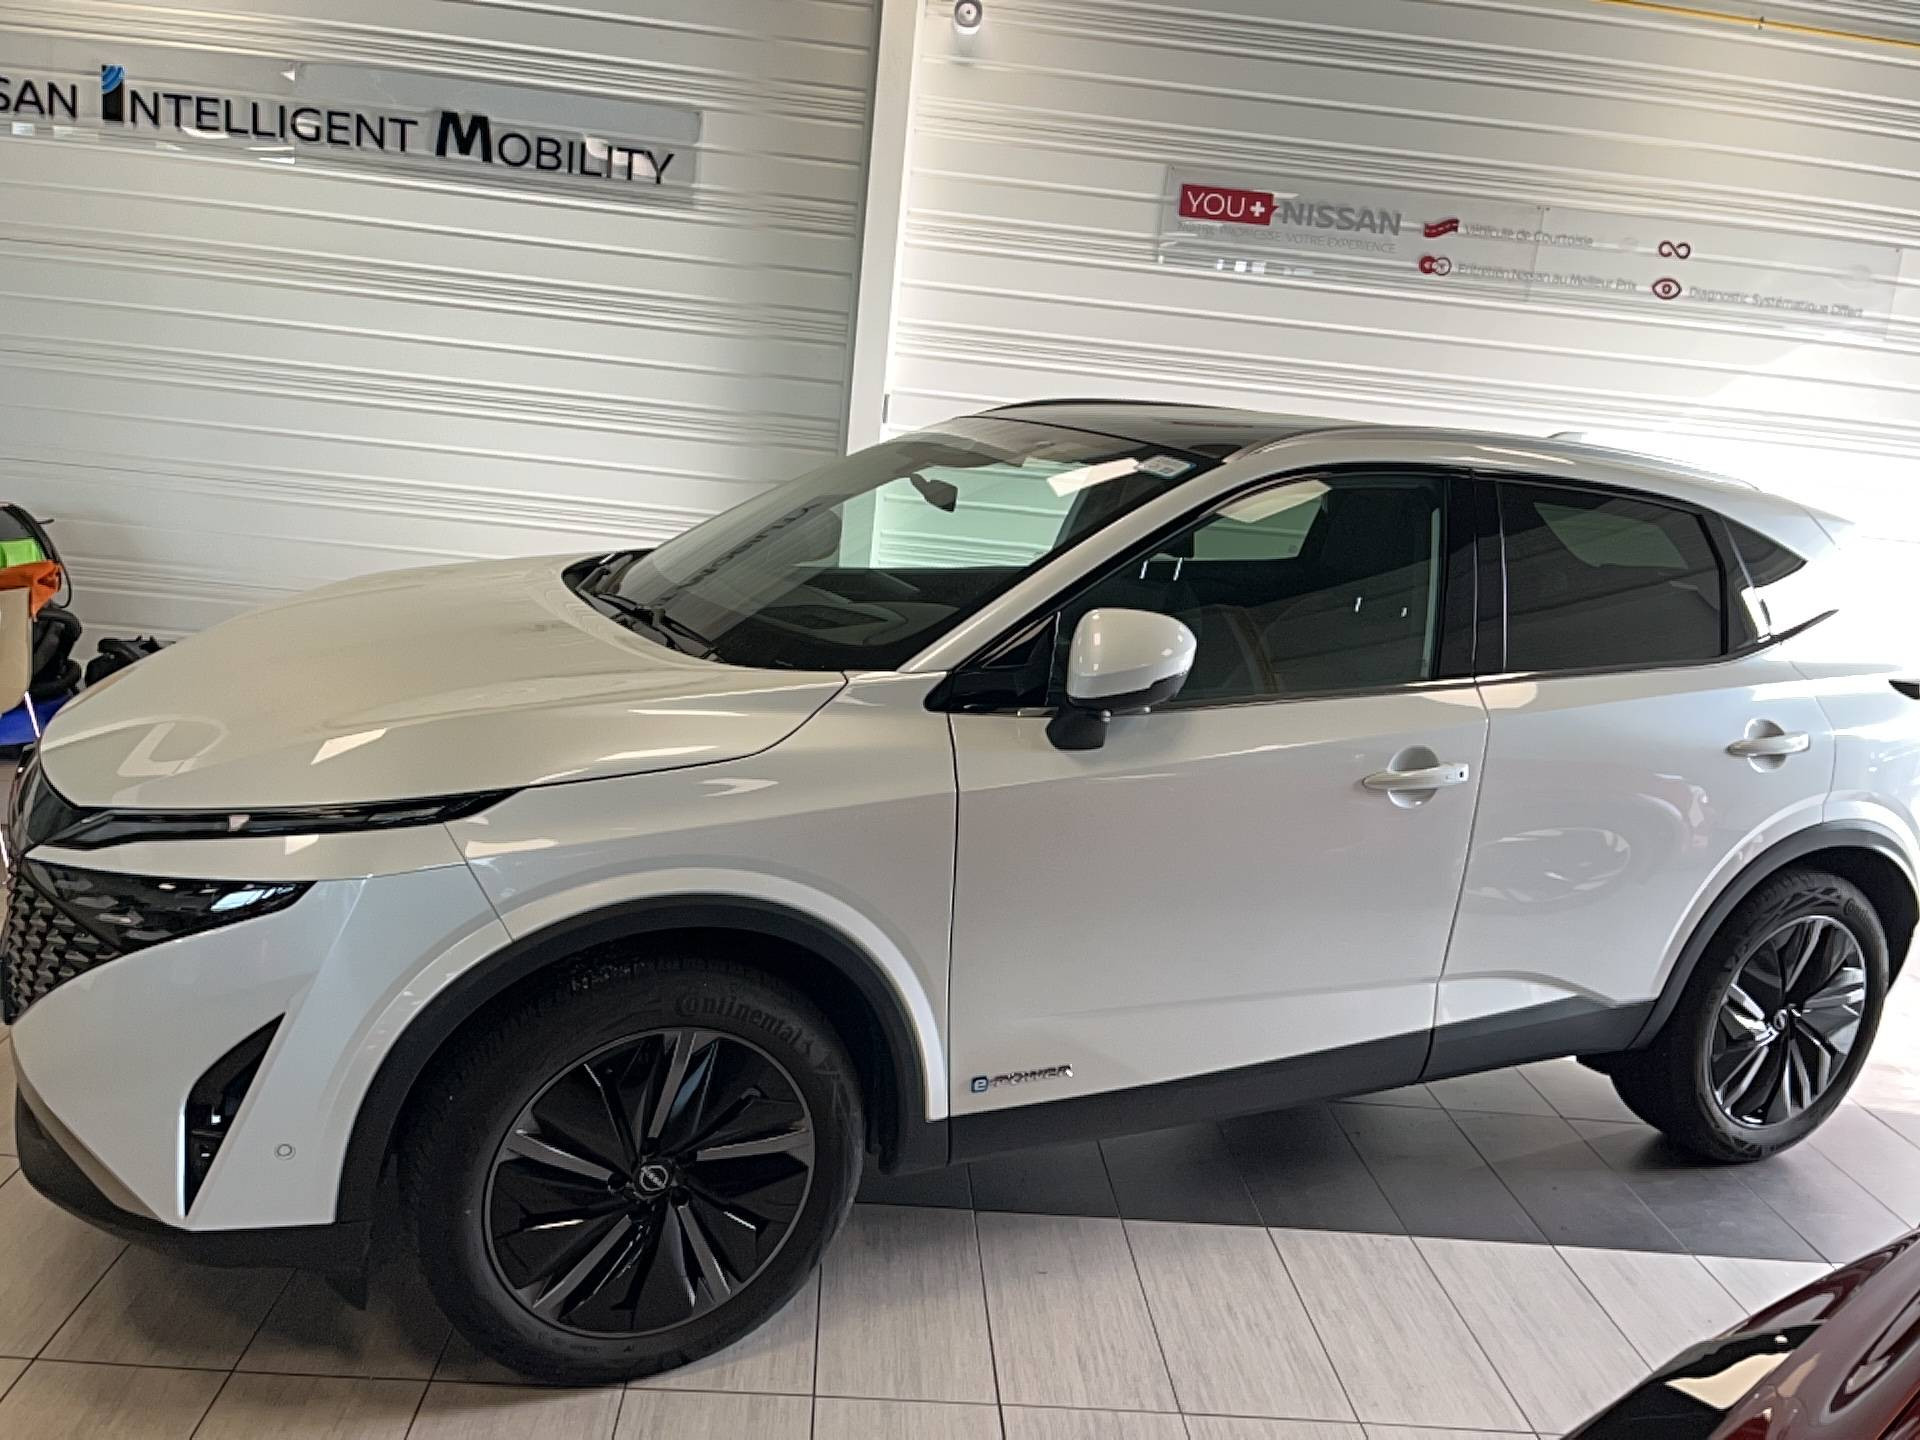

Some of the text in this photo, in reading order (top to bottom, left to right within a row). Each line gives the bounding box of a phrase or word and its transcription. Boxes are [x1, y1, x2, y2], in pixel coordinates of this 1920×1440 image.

[101, 64, 419, 153] INTELLIGENT
[435, 111, 675, 185] MOBILITY
[1282, 200, 1403, 236] NISSAN
[674, 996, 803, 1047] Continental
